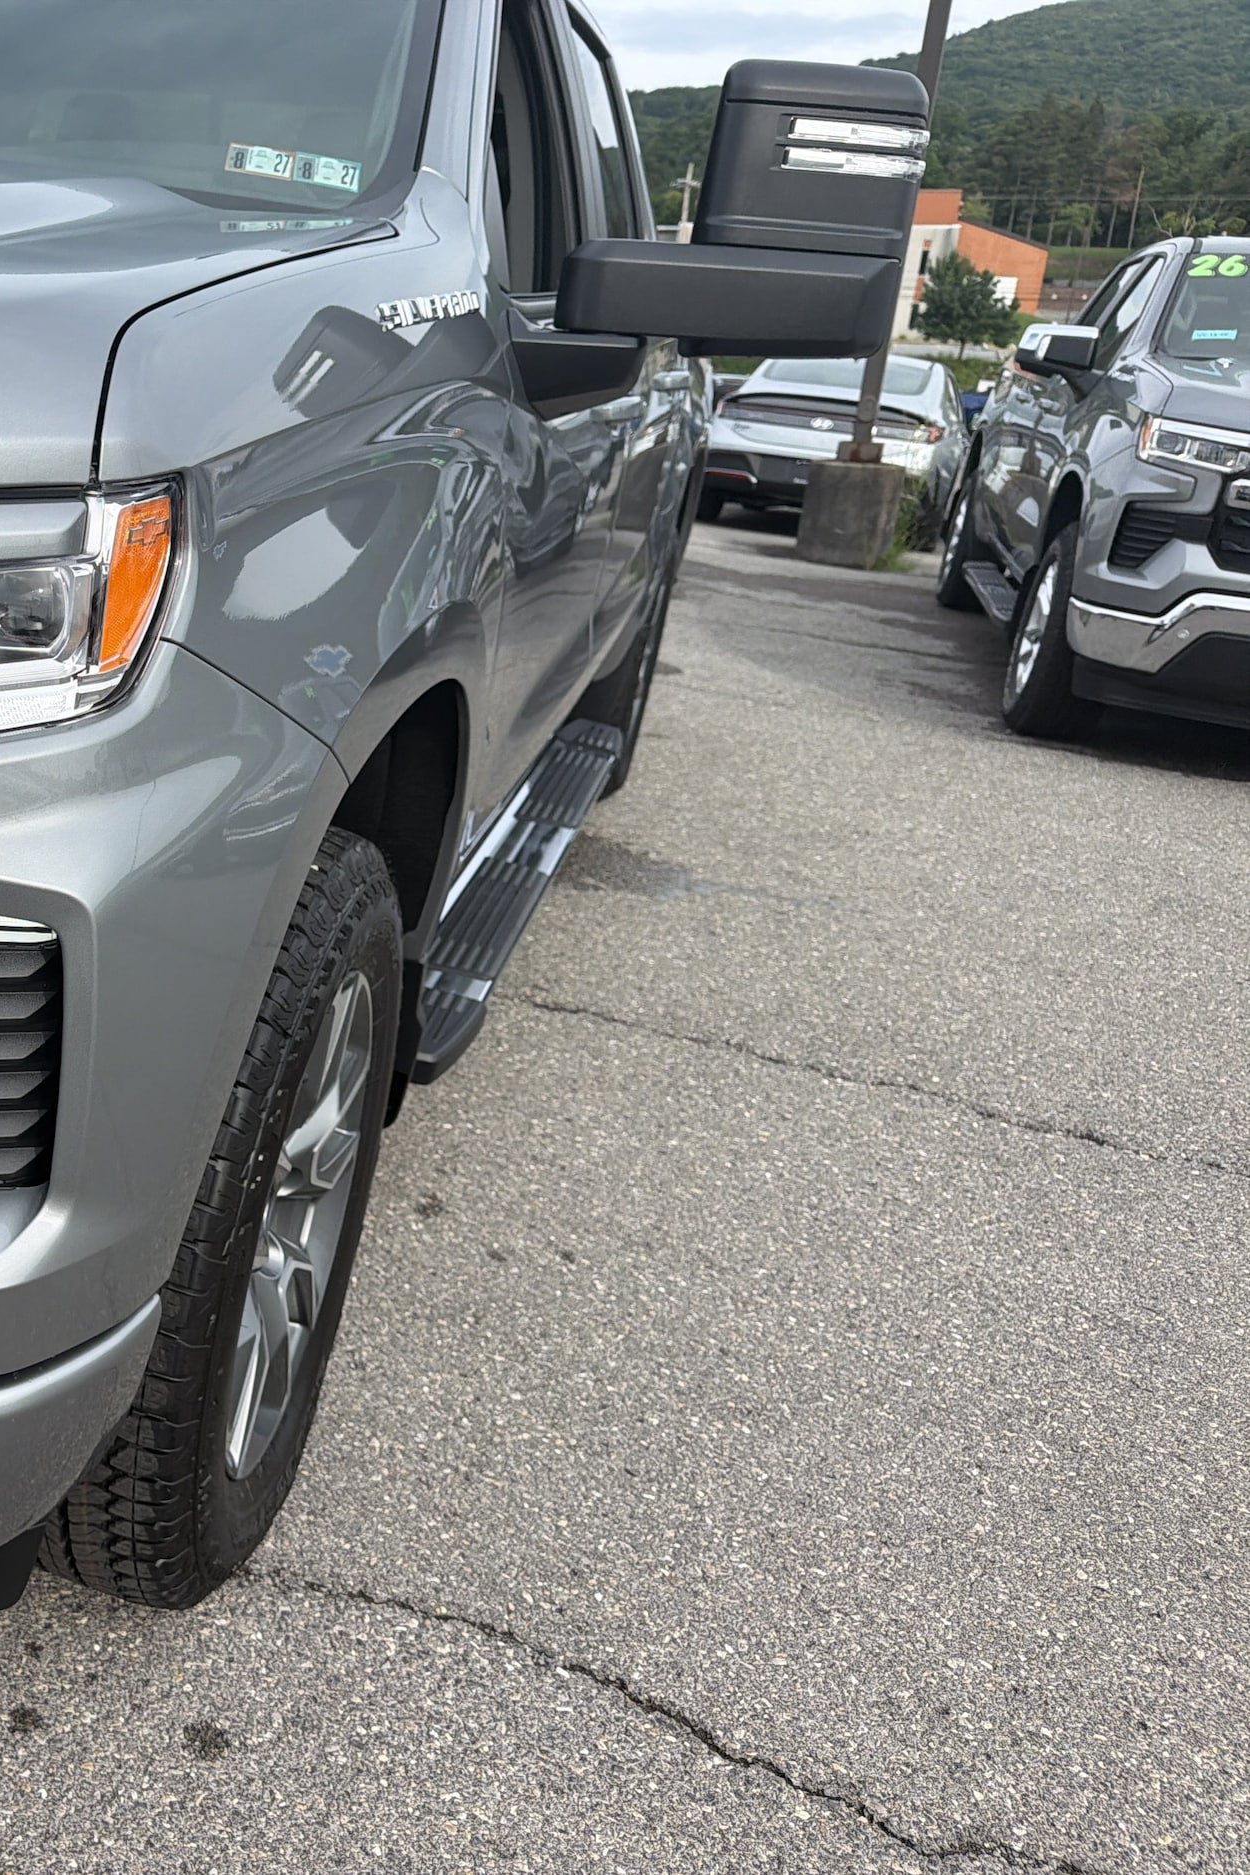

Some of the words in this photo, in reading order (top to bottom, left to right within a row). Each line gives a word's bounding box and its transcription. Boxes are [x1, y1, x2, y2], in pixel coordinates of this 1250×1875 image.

[273, 153, 290, 175] 27
[340, 165, 357, 187] 27
[1187, 254, 1248, 278] 26
